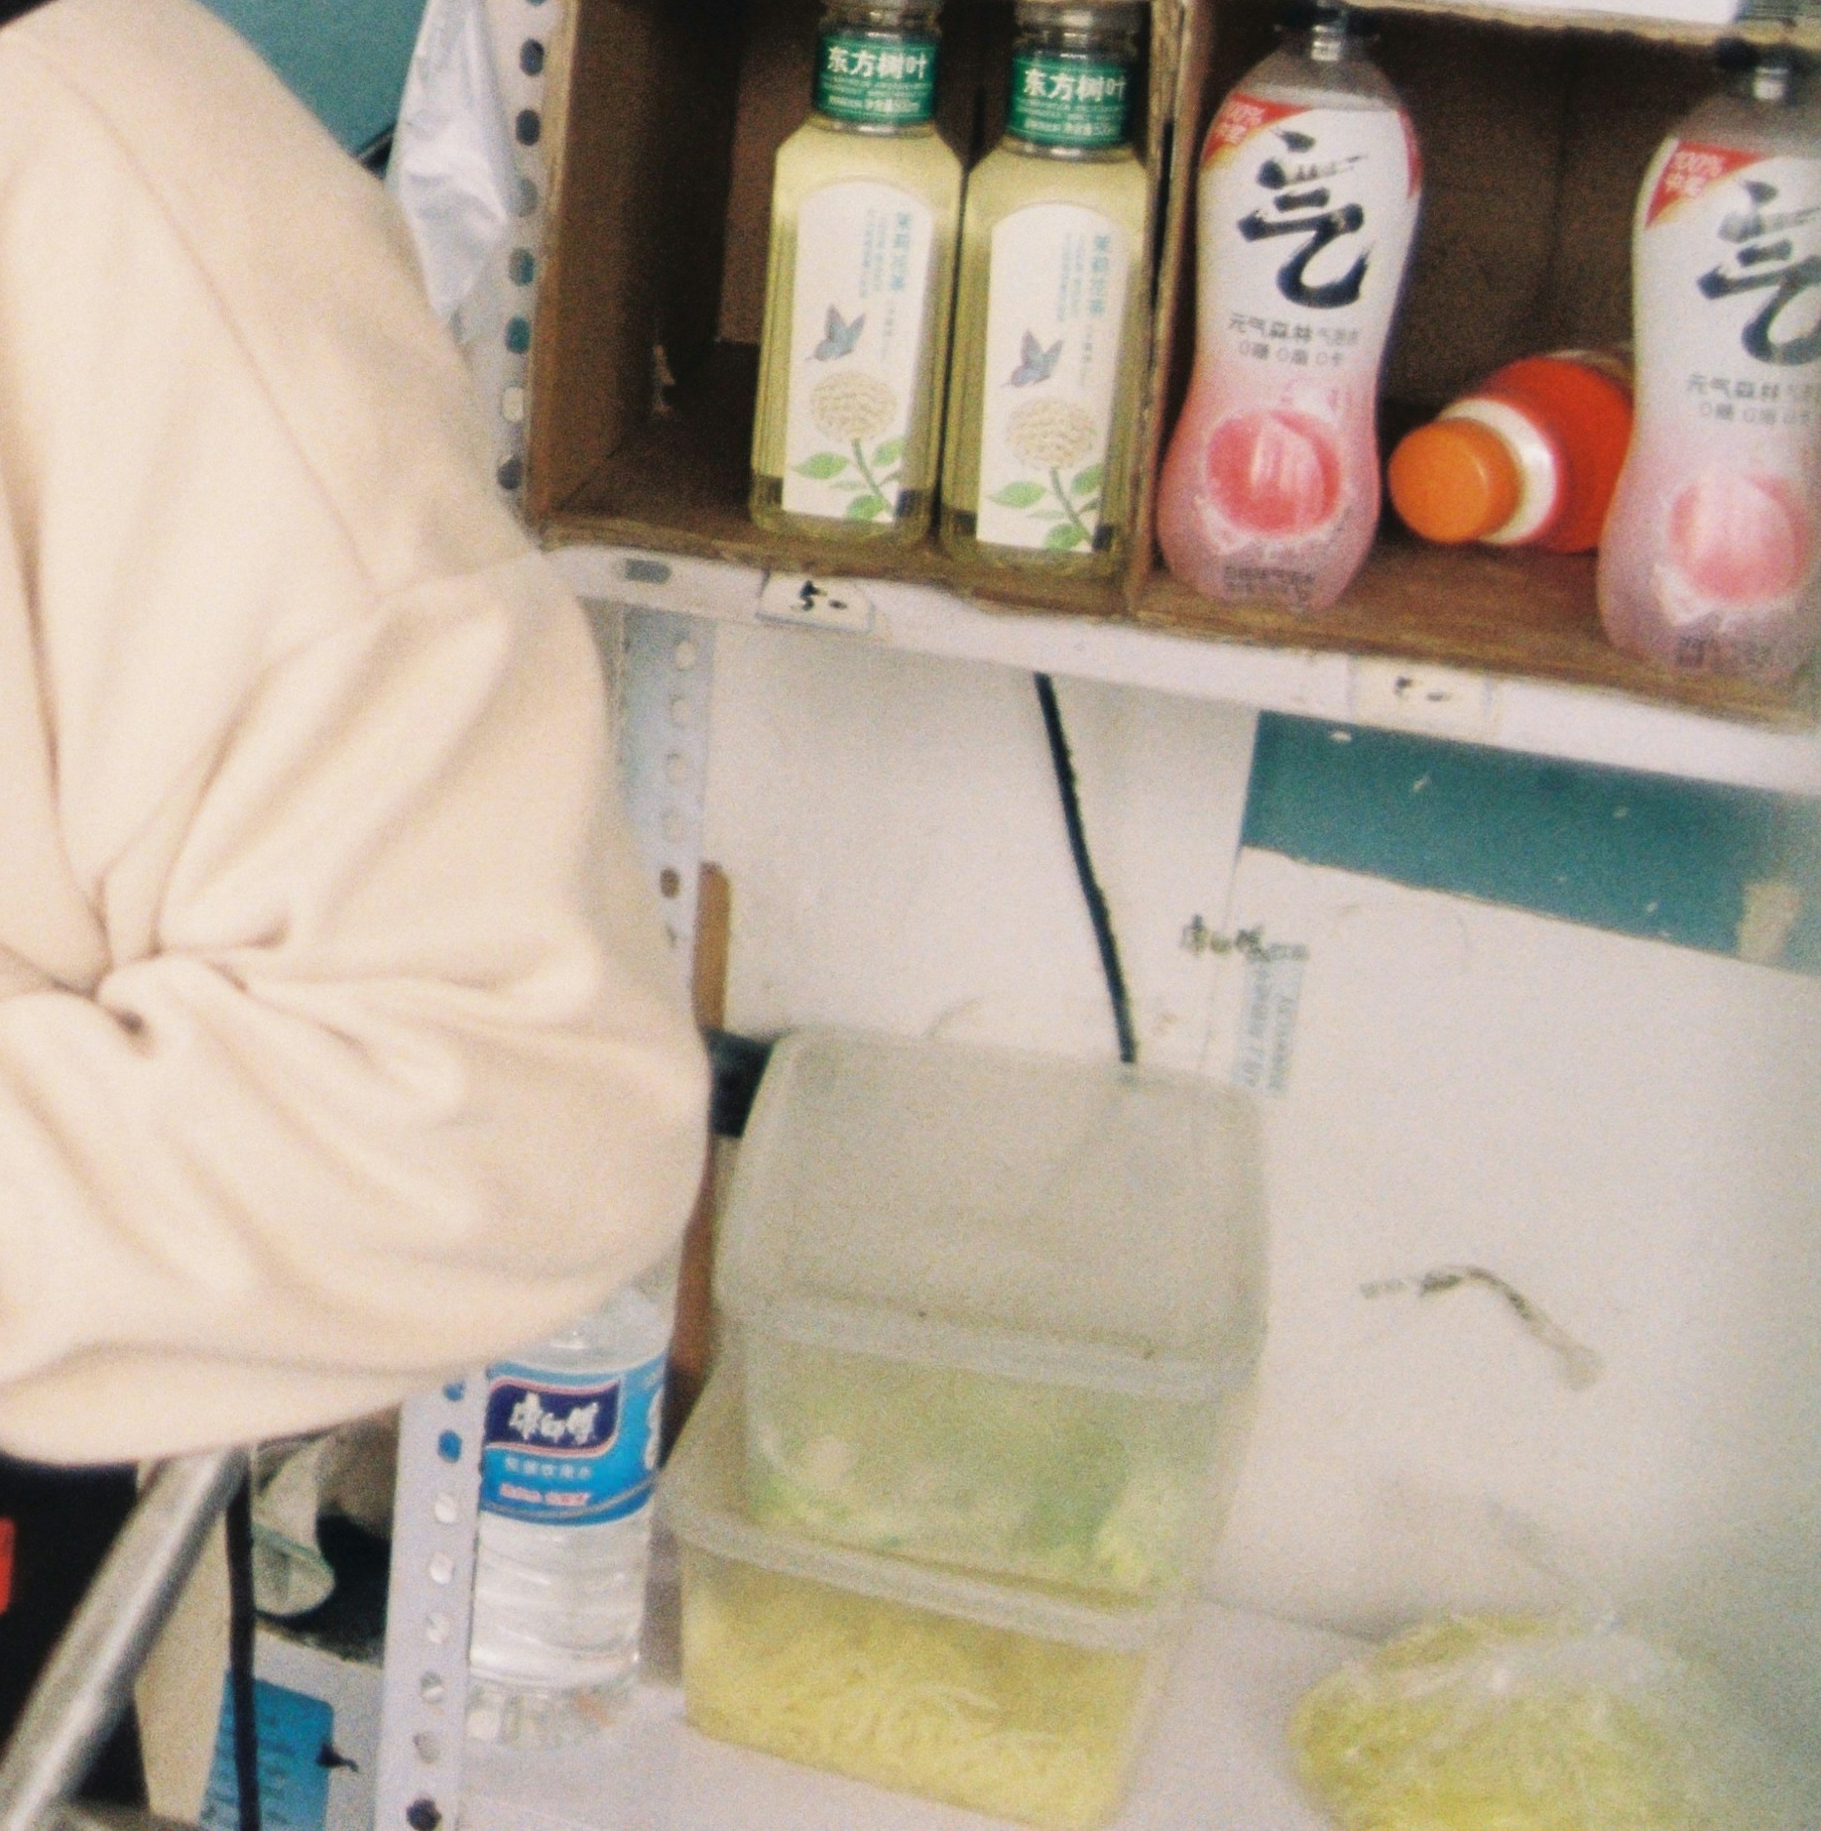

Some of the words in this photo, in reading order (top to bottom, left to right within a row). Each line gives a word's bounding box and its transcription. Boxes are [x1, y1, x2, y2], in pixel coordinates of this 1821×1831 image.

[827, 46, 927, 80] 东方树叶
[1023, 68, 1127, 103] 东方树叶
